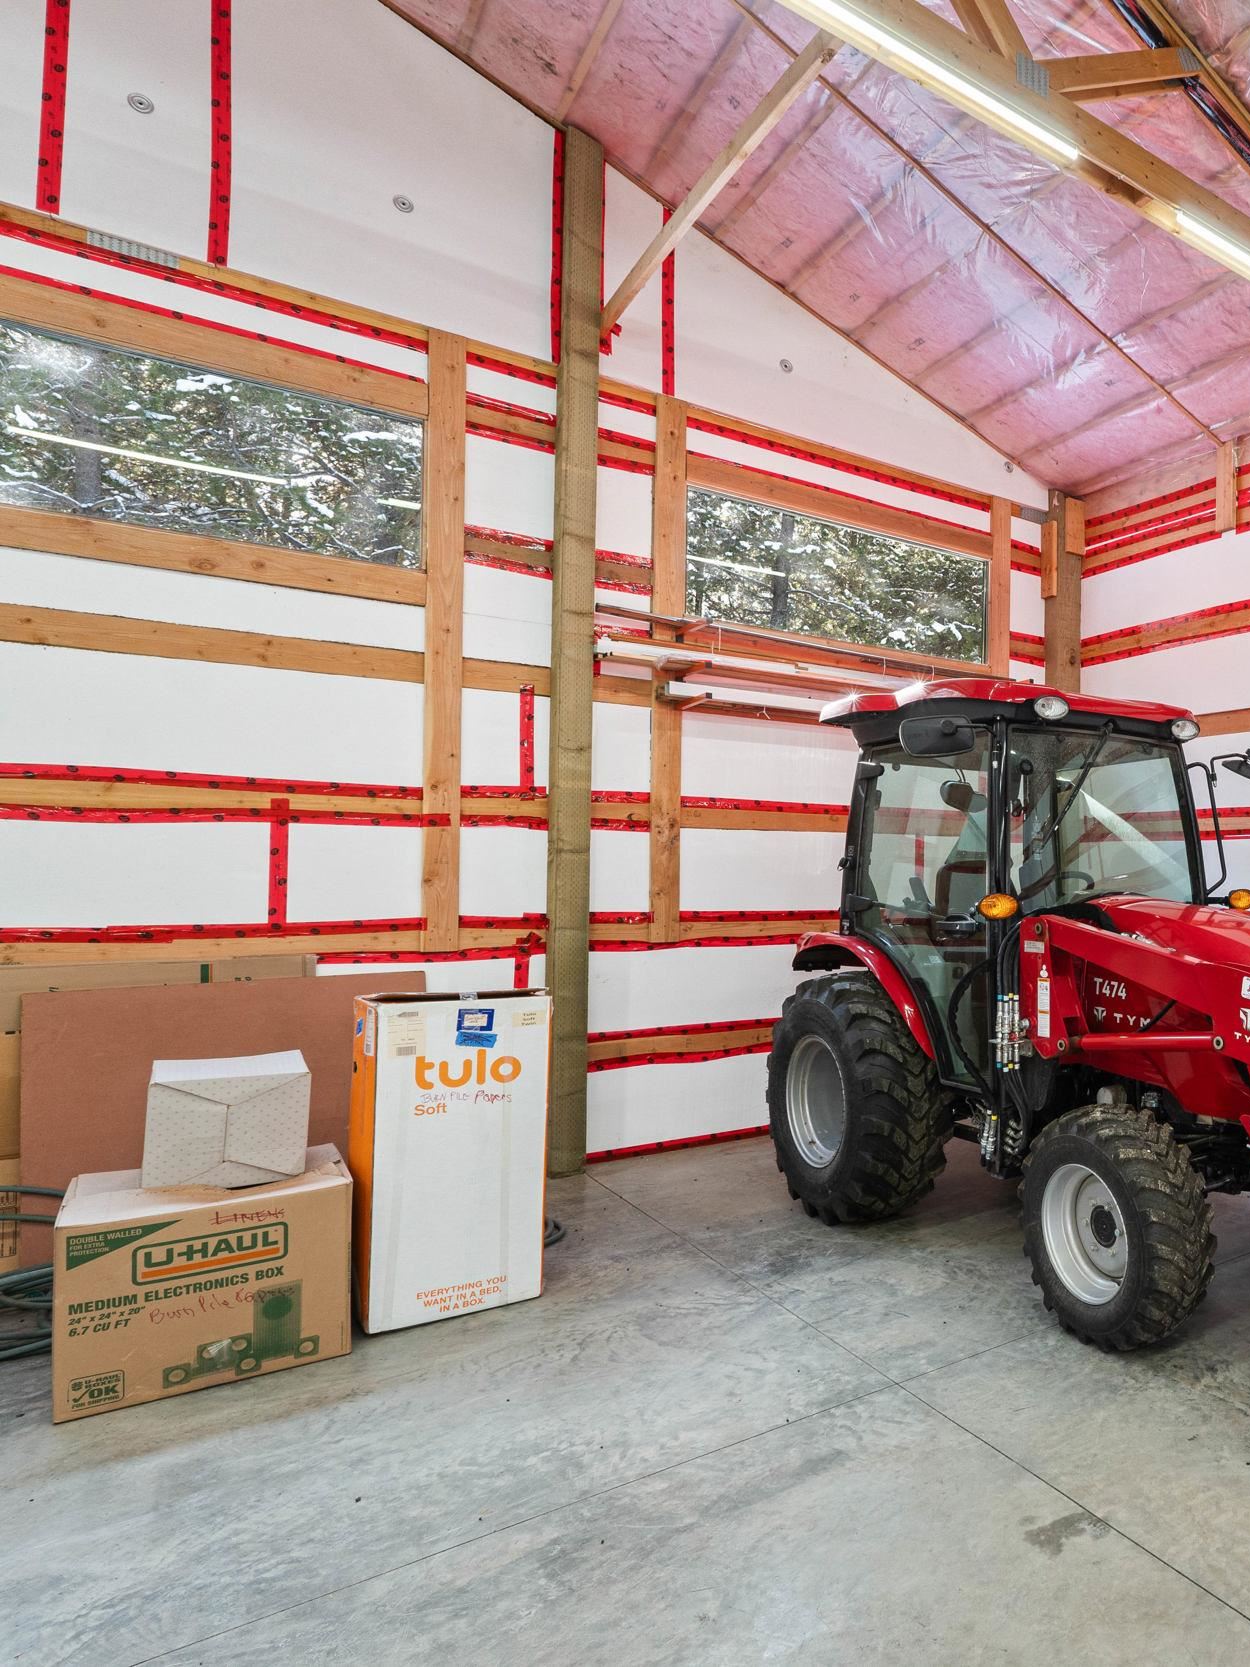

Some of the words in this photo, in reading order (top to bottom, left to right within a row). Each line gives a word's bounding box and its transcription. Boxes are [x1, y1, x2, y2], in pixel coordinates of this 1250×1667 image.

[1094, 977, 1127, 1000] T474
[1113, 1012, 1151, 1028] TYM
[415, 1049, 522, 1090] tulo
[414, 1103, 448, 1116] Soft
[69, 1234, 106, 1246] DOUBLE
[106, 1228, 143, 1241] WALLED
[69, 1244, 83, 1252] FOR
[83, 1242, 106, 1250] EXTRA
[69, 1247, 110, 1257] PROTECTION
[144, 1230, 279, 1269] U-HAUL
[68, 1294, 138, 1316] MEDIUM
[144, 1273, 249, 1302] ELECTRONICS
[255, 1265, 285, 1281] BOX
[416, 1280, 483, 1300] EVERYTHING
[486, 1275, 508, 1286] YOU
[423, 1295, 454, 1308] WANT
[456, 1290, 467, 1301] IN
[469, 1290, 477, 1299] A
[480, 1285, 502, 1296] BED.
[439, 1304, 450, 1313] IN
[453, 1302, 460, 1310] A
[462, 1297, 487, 1308] BOX.
[68, 1326, 91, 1338] 6.7
[93, 1321, 111, 1333] CU
[114, 1318, 131, 1329] FT
[88, 1384, 120, 1400] OK
